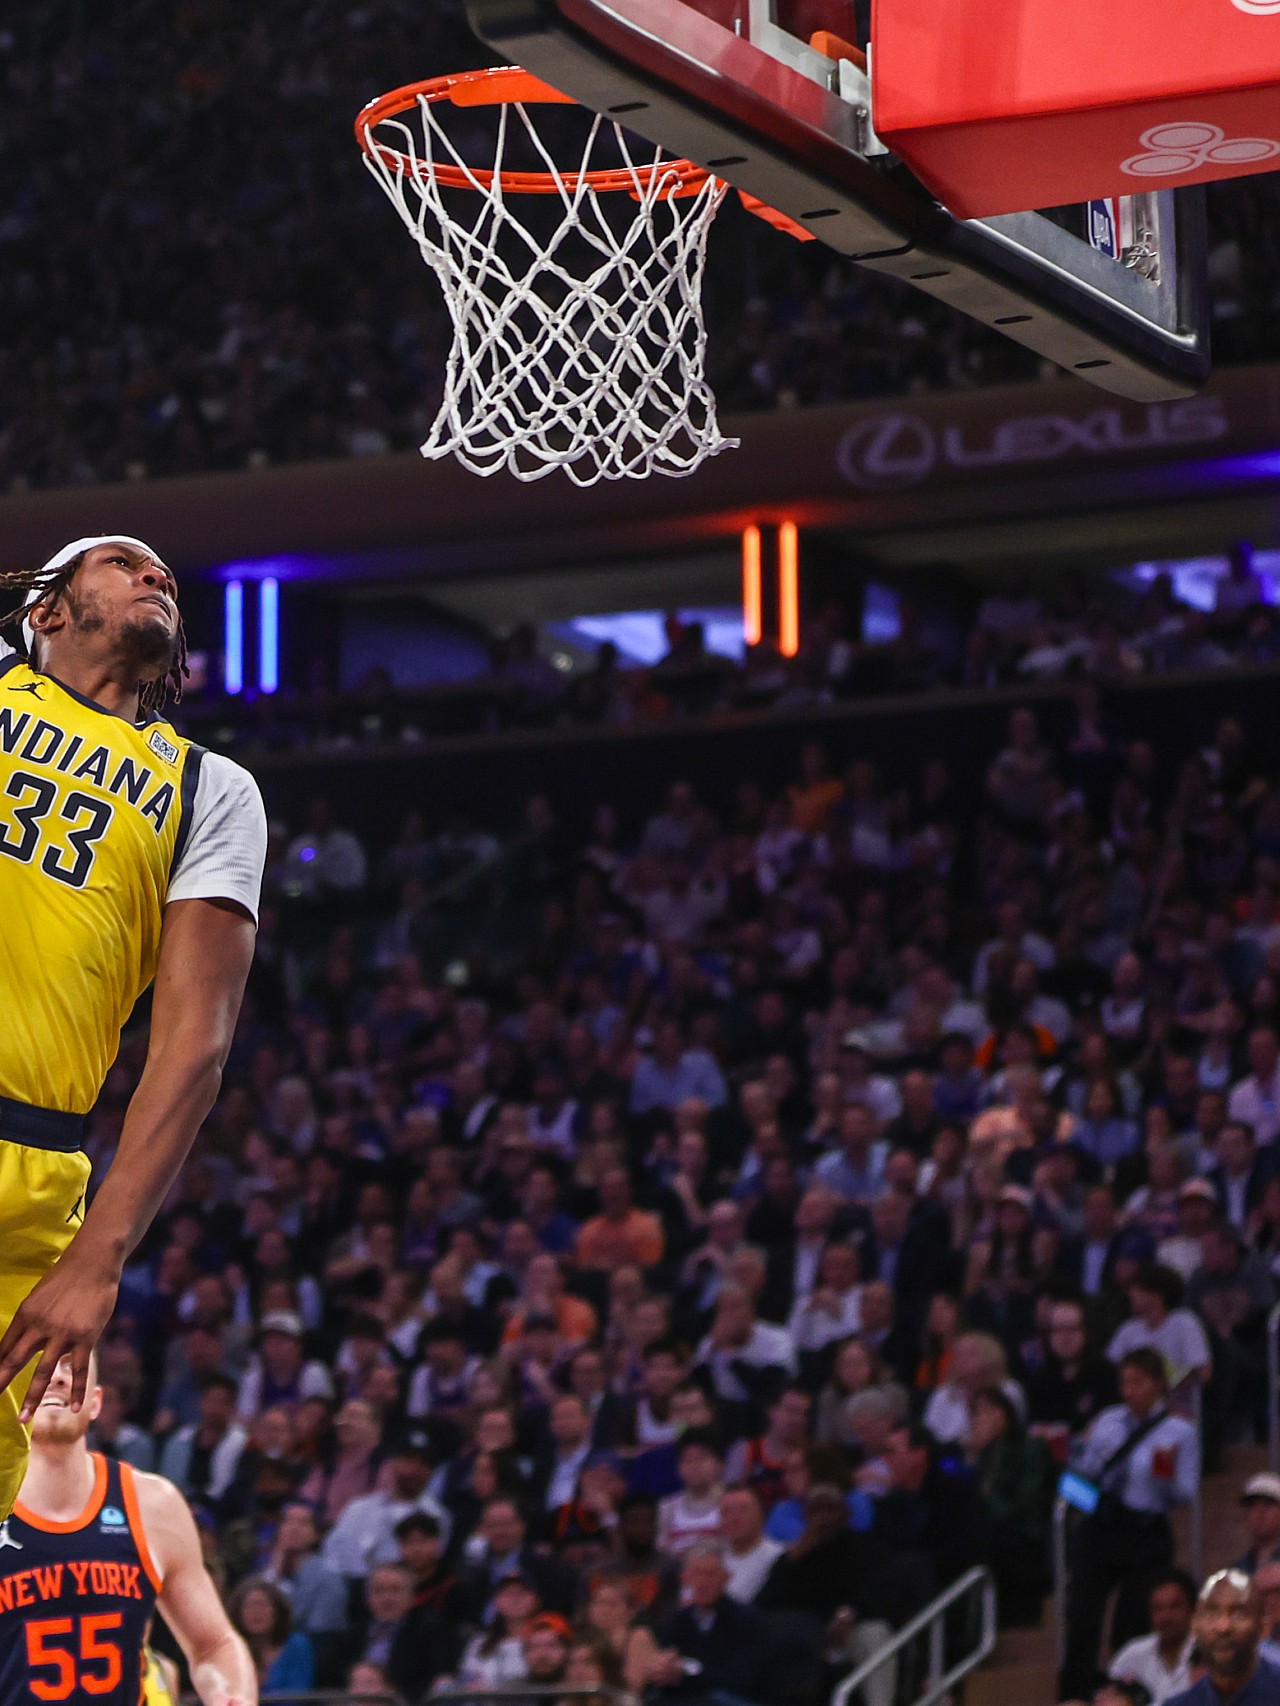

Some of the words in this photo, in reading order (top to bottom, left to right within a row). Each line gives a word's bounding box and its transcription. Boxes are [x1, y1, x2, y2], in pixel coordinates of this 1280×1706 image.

[944, 398, 1228, 467] LEXUS
[67, 1560, 143, 1601] YORK
[24, 1611, 123, 1702] 55
